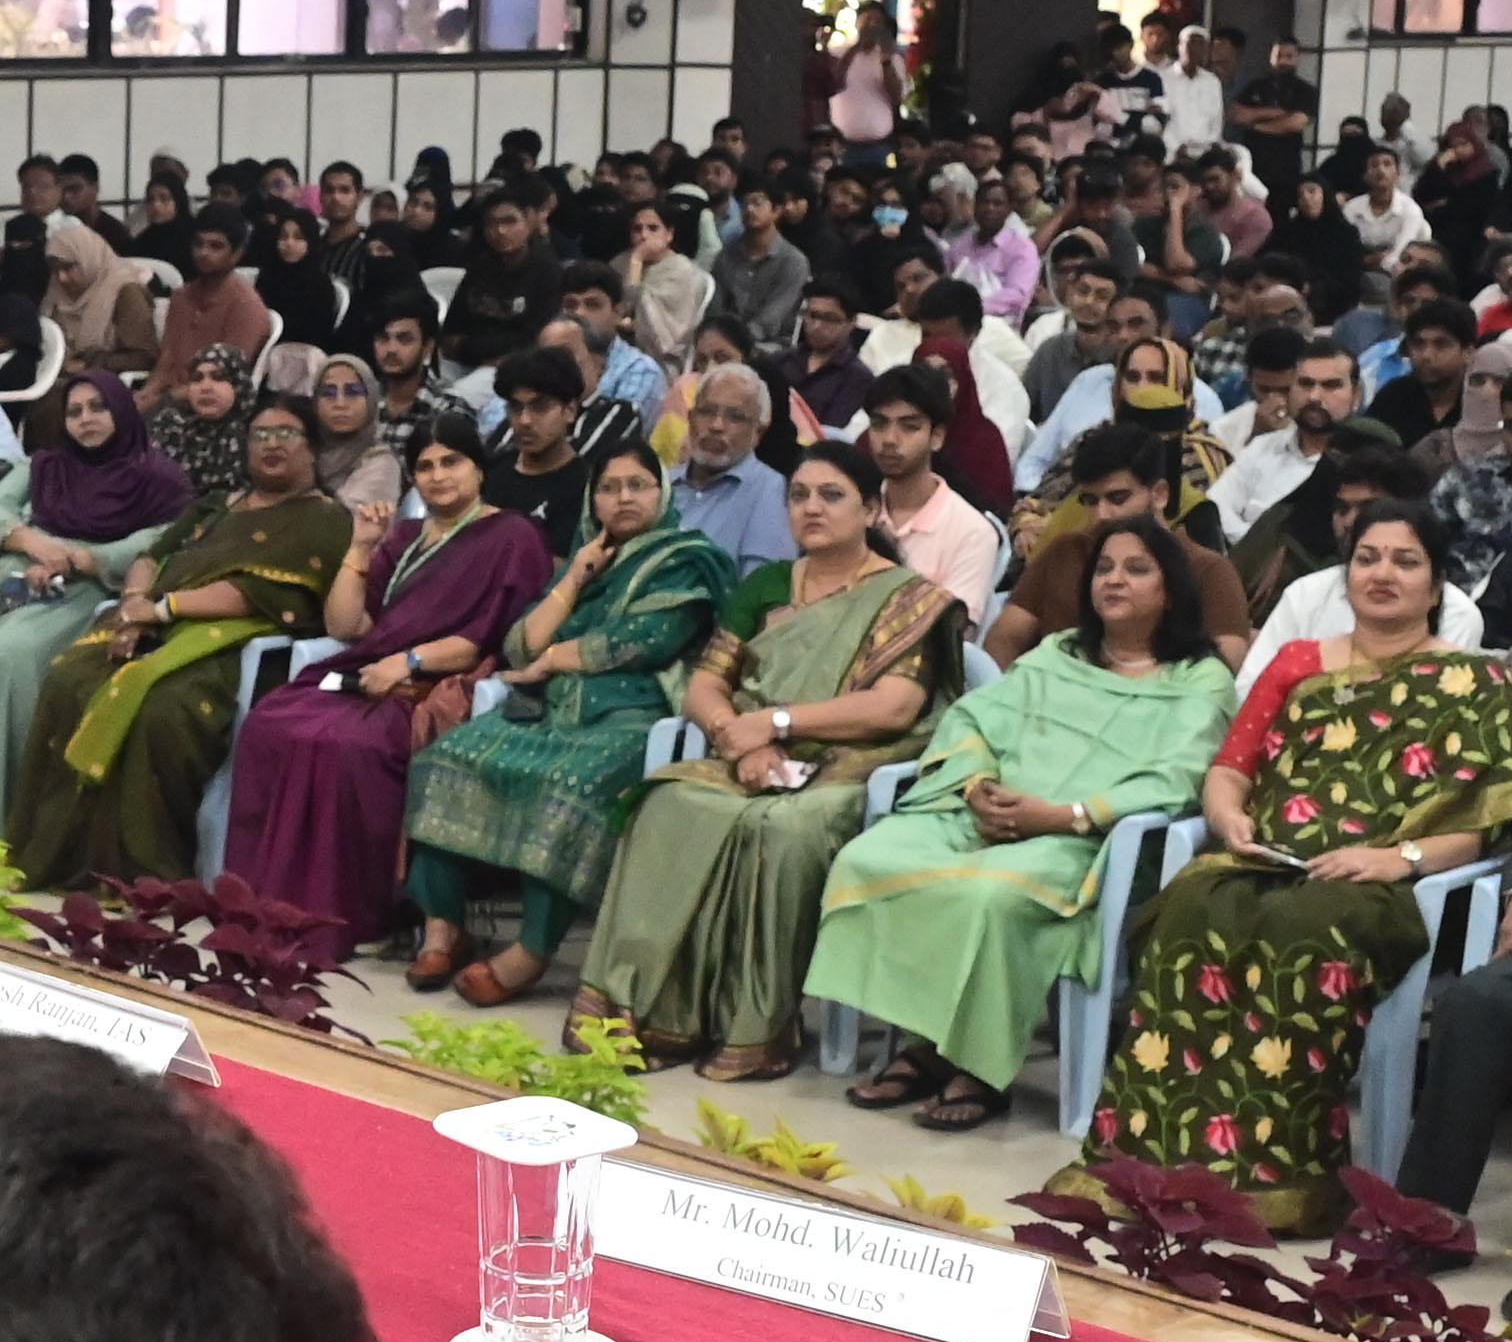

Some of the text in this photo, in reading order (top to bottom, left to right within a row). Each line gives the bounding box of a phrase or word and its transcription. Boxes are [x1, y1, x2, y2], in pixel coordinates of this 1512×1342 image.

[104, 1016, 153, 1047] IAS
[661, 1187, 976, 1285] Mr. Mohd. Waliullah
[715, 1256, 887, 1314] Chairman, SUES
